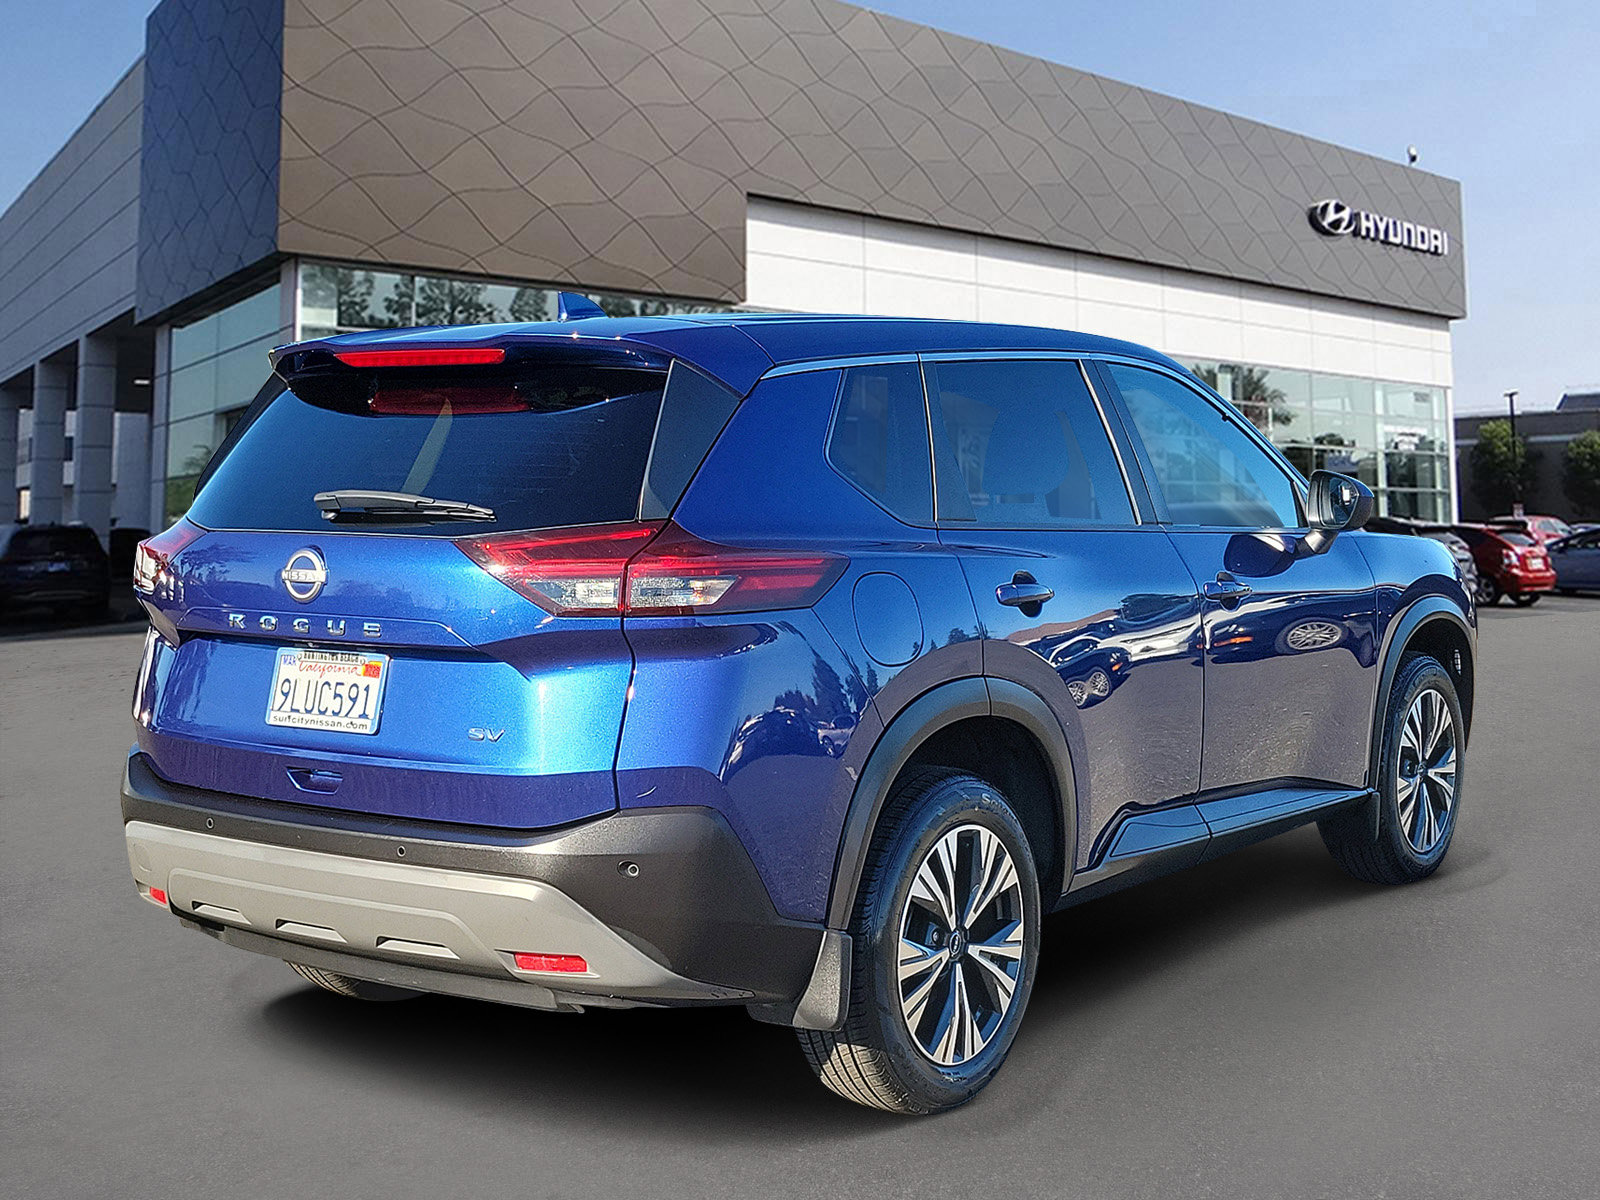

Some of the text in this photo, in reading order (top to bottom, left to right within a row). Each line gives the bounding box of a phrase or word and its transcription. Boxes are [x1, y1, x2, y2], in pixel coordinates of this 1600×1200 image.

[1360, 211, 1448, 255] HYUNDAI
[283, 570, 324, 582] NISSA
[228, 613, 382, 638] ROGUE
[299, 660, 362, 679] California
[278, 678, 370, 719] 9LUC591
[273, 715, 368, 730] surfcitynissan.com
[468, 727, 505, 742] SV
